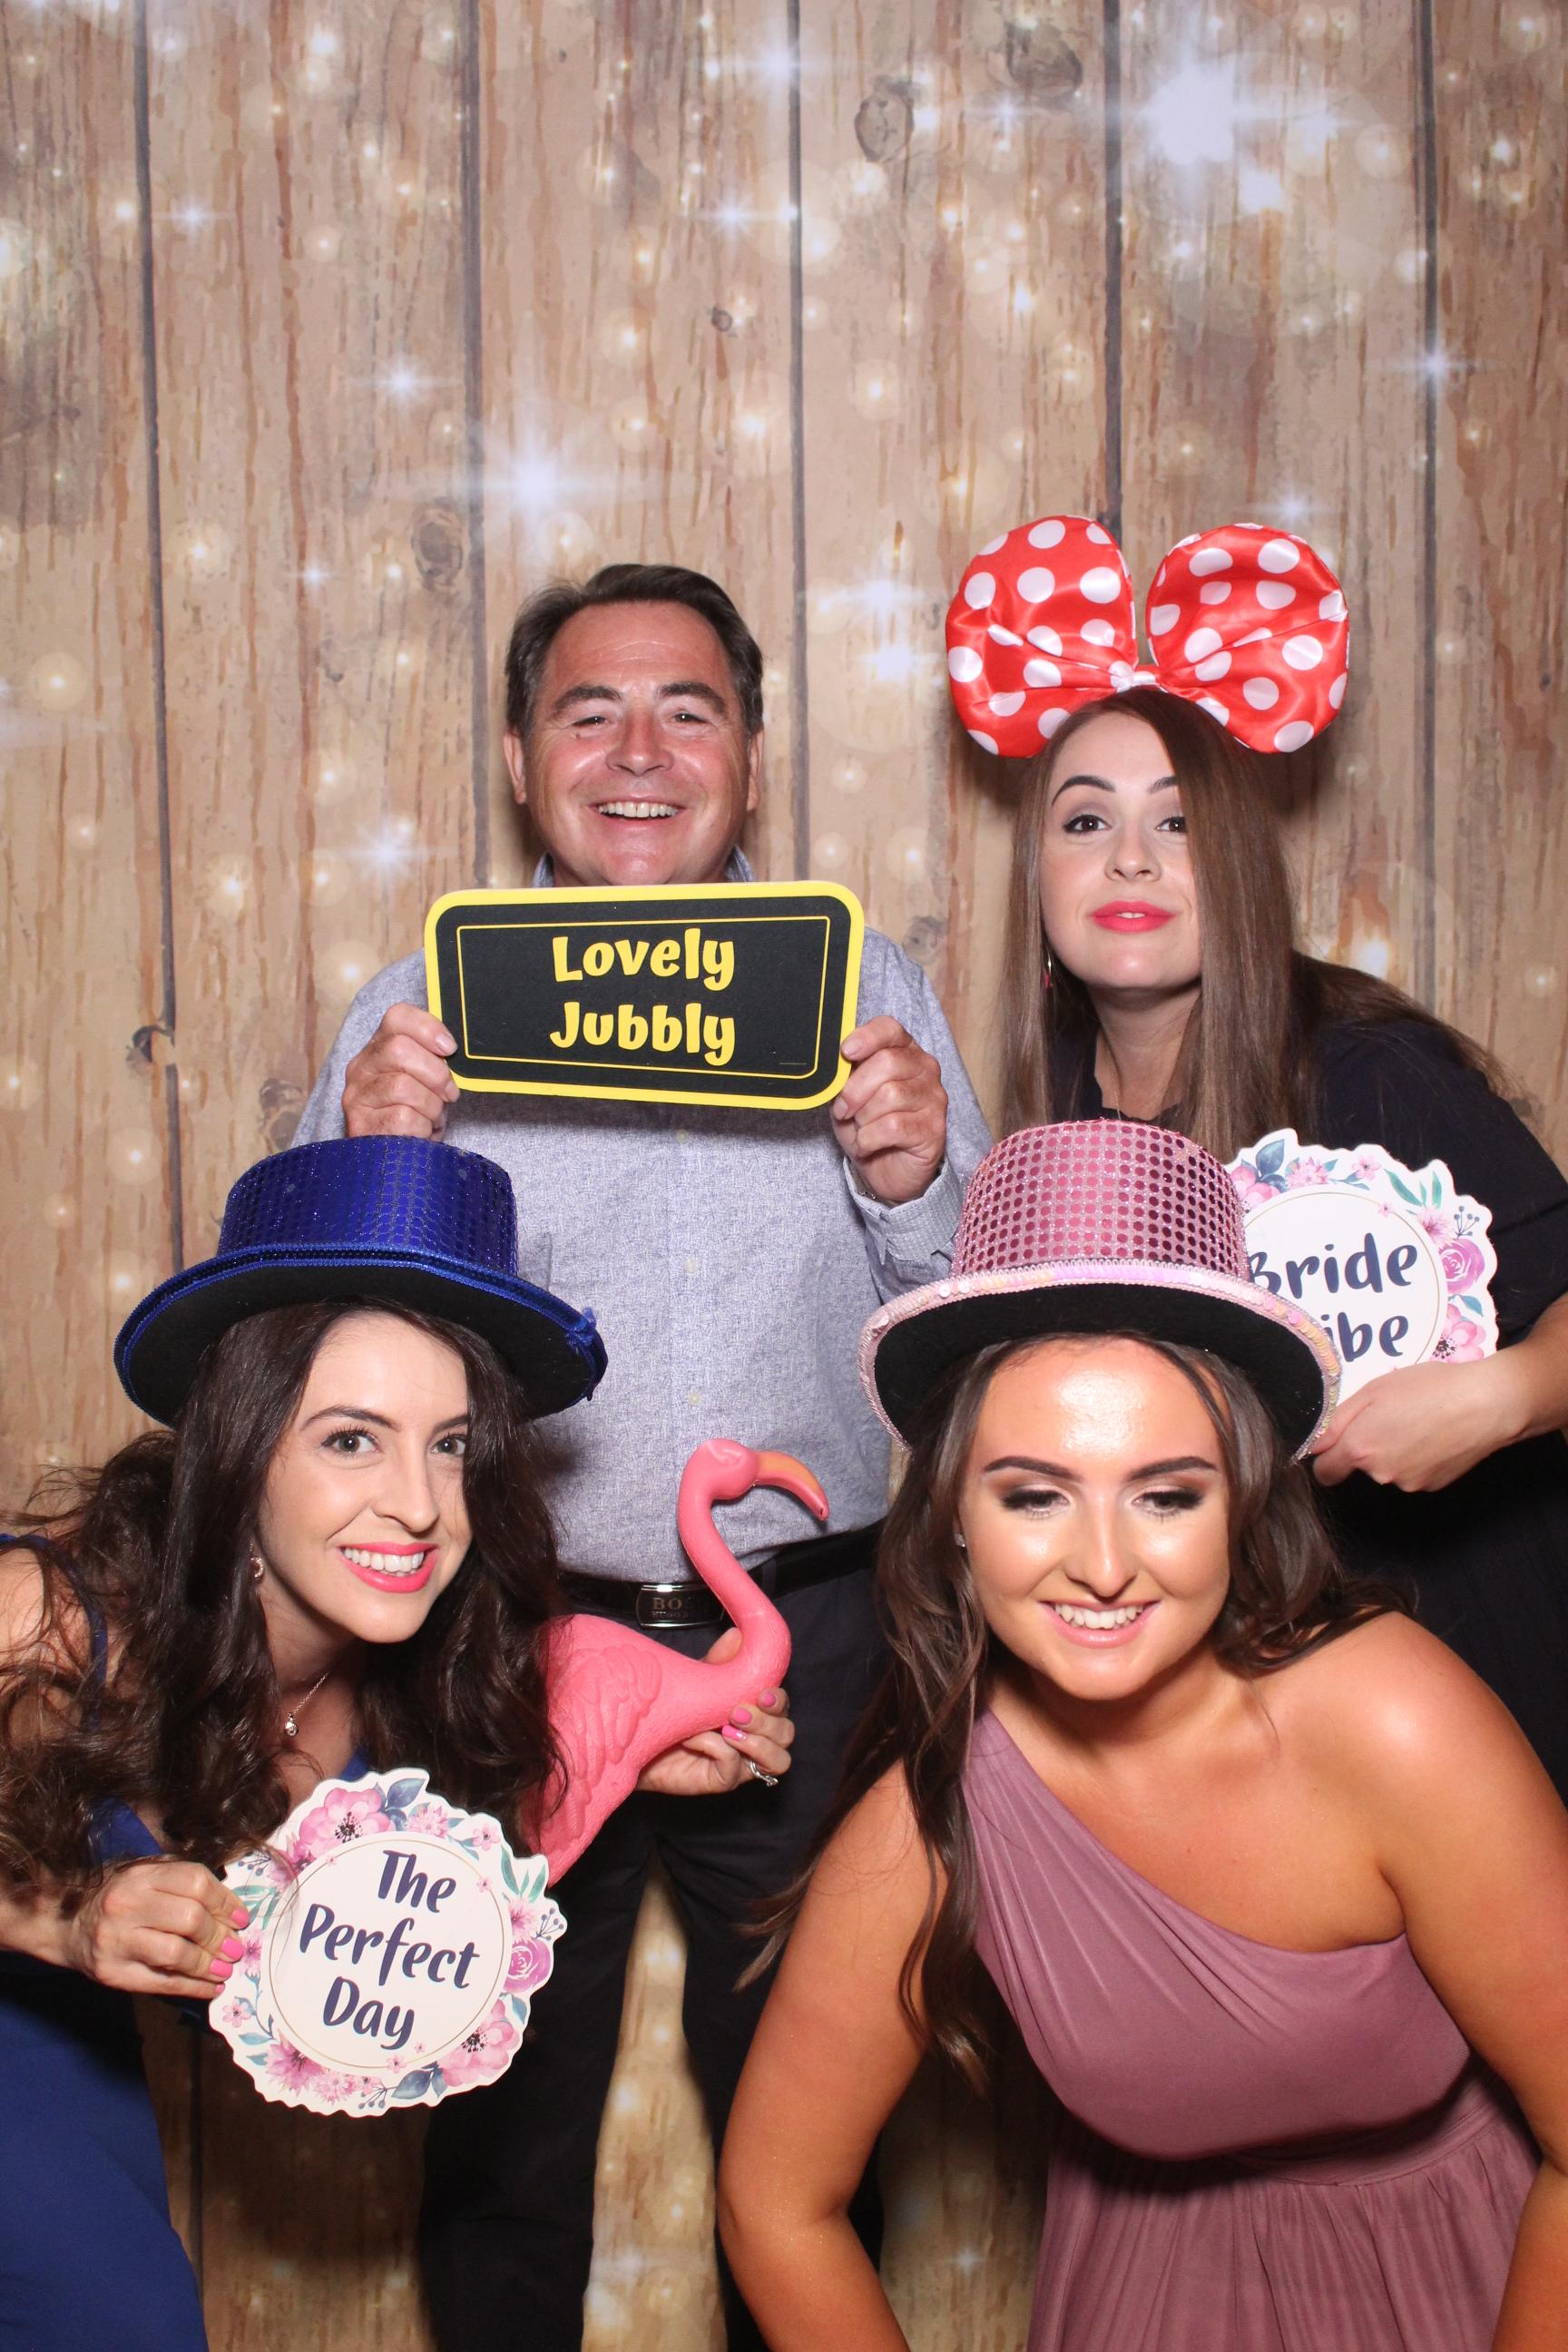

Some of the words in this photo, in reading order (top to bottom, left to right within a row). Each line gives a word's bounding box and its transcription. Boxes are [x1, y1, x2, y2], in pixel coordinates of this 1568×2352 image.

[552, 927, 735, 992] Lovely
[549, 1002, 736, 1067] Jubbly
[1248, 1232, 1417, 1299] Bride
[377, 1850, 456, 1913] The
[299, 1903, 480, 1989] Perfect
[323, 1975, 416, 2051] Day
